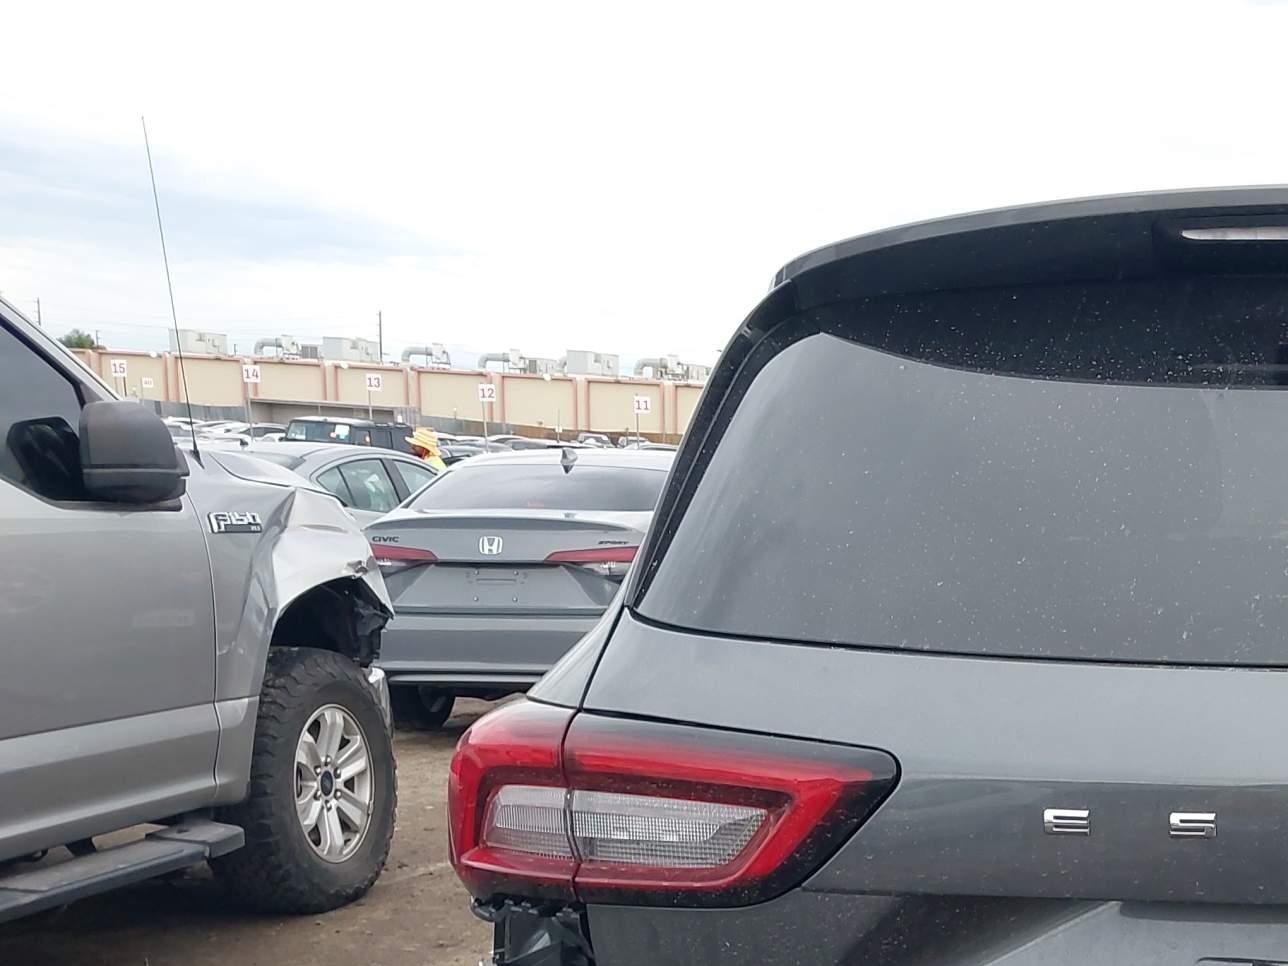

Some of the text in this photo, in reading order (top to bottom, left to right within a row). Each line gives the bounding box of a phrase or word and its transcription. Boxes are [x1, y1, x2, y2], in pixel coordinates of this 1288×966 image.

[112, 362, 125, 374] 15
[244, 368, 259, 380] 14
[367, 377, 380, 388] 13
[480, 388, 495, 399] 12
[635, 399, 649, 411] 11
[372, 535, 399, 543] CIVIC
